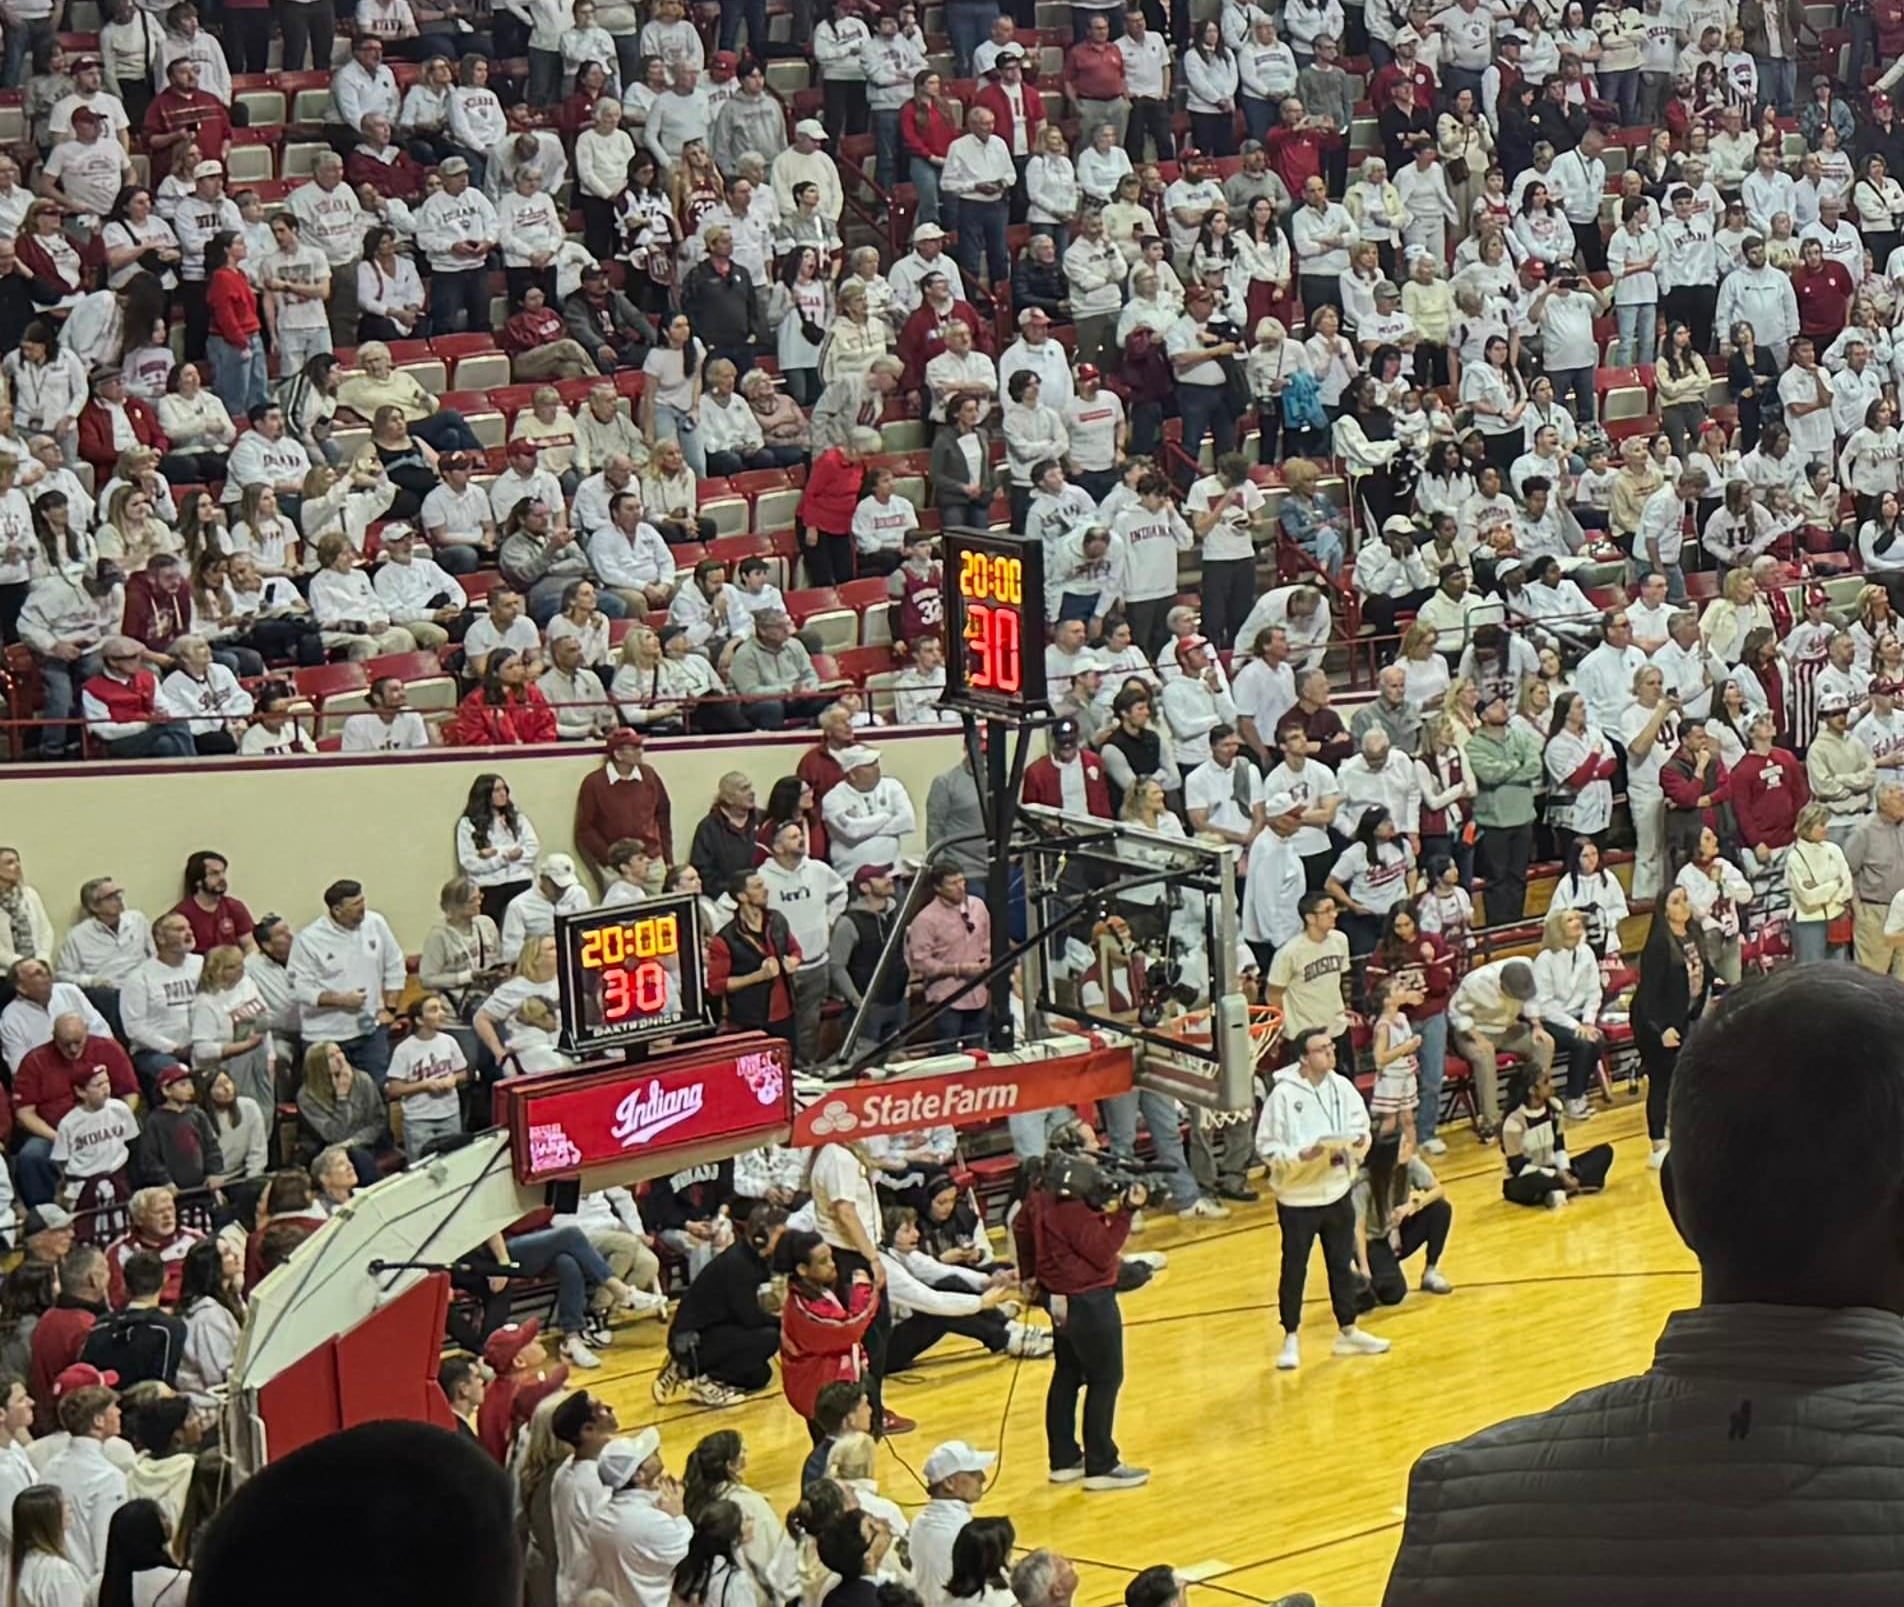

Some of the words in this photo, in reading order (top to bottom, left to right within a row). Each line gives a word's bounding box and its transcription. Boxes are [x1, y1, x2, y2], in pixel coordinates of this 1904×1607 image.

[959, 548, 1022, 605] 20:00
[967, 603, 1020, 693] 30
[580, 915, 679, 970] 20:00
[602, 961, 667, 1019] 30
[611, 1079, 704, 1147] Indiana
